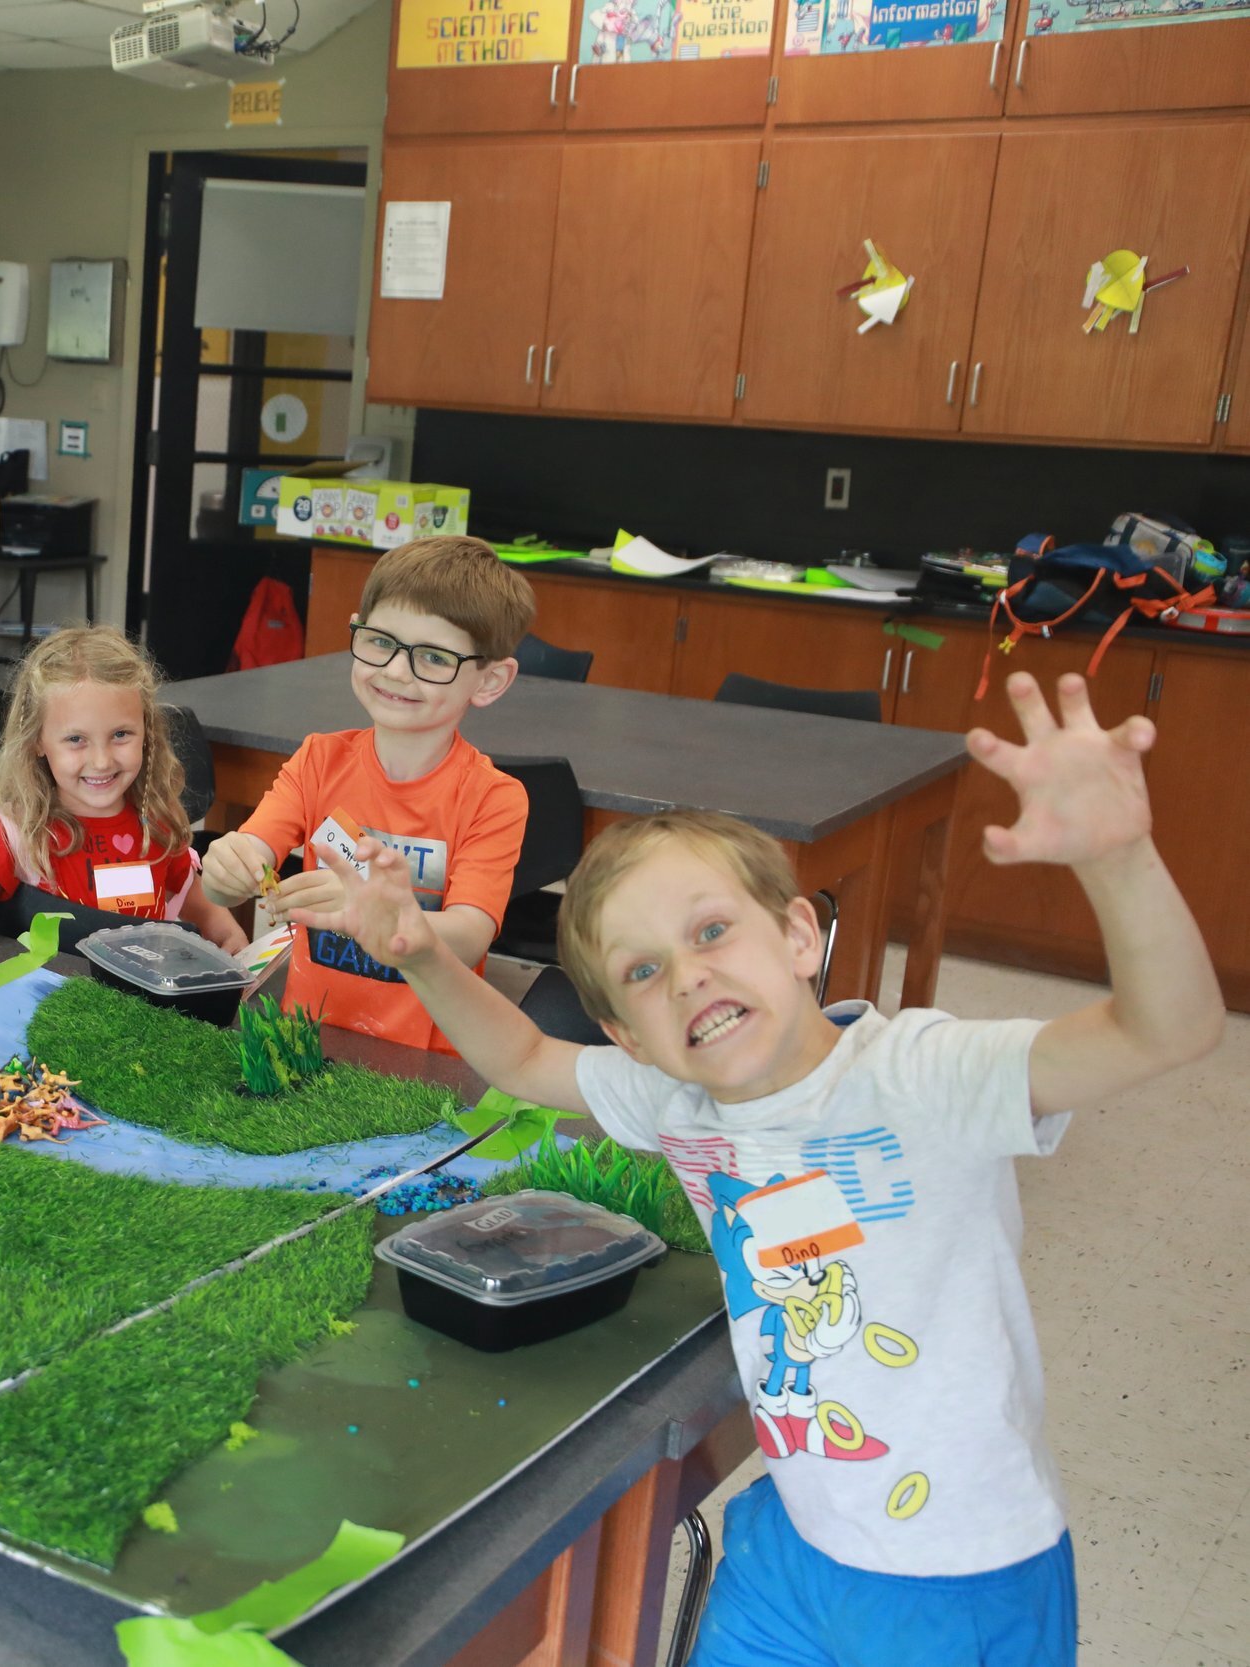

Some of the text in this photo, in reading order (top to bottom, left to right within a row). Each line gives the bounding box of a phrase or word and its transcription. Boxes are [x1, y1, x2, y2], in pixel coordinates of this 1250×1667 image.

[711, 3, 742, 20] the
[872, 0, 978, 24] Information
[426, 11, 540, 39] SCIENTIFIC
[682, 19, 769, 40] Question
[437, 39, 524, 63] METHOD
[296, 498, 310, 512] 28
[116, 897, 135, 908] Dino
[474, 1209, 514, 1230] GLAD
